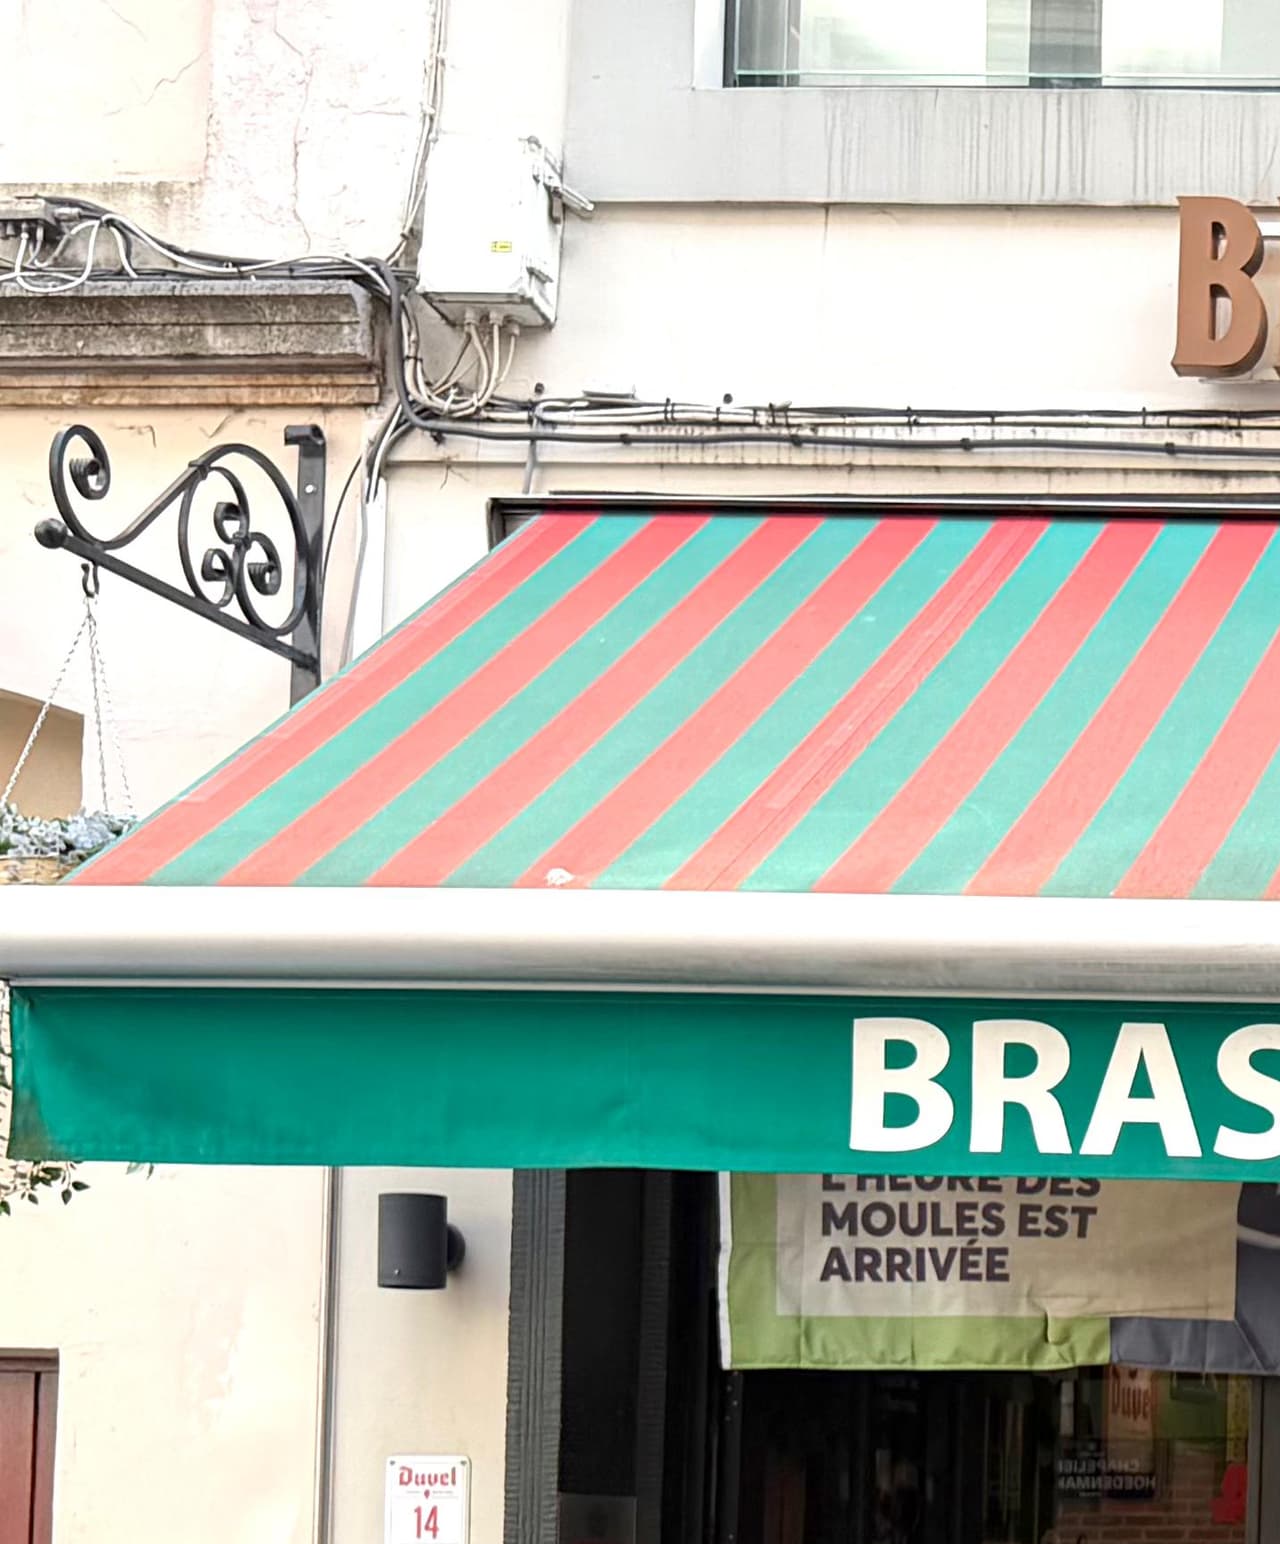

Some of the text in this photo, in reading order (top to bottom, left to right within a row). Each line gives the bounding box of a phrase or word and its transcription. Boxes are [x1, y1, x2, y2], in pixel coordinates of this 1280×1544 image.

[822, 1173, 1101, 1196] LHEURE DES
[821, 1201, 1098, 1238] MOULES EST
[819, 1239, 1010, 1283] ARRIVÉE
[399, 1465, 457, 1486] Duvel
[414, 1504, 440, 1540] 14
